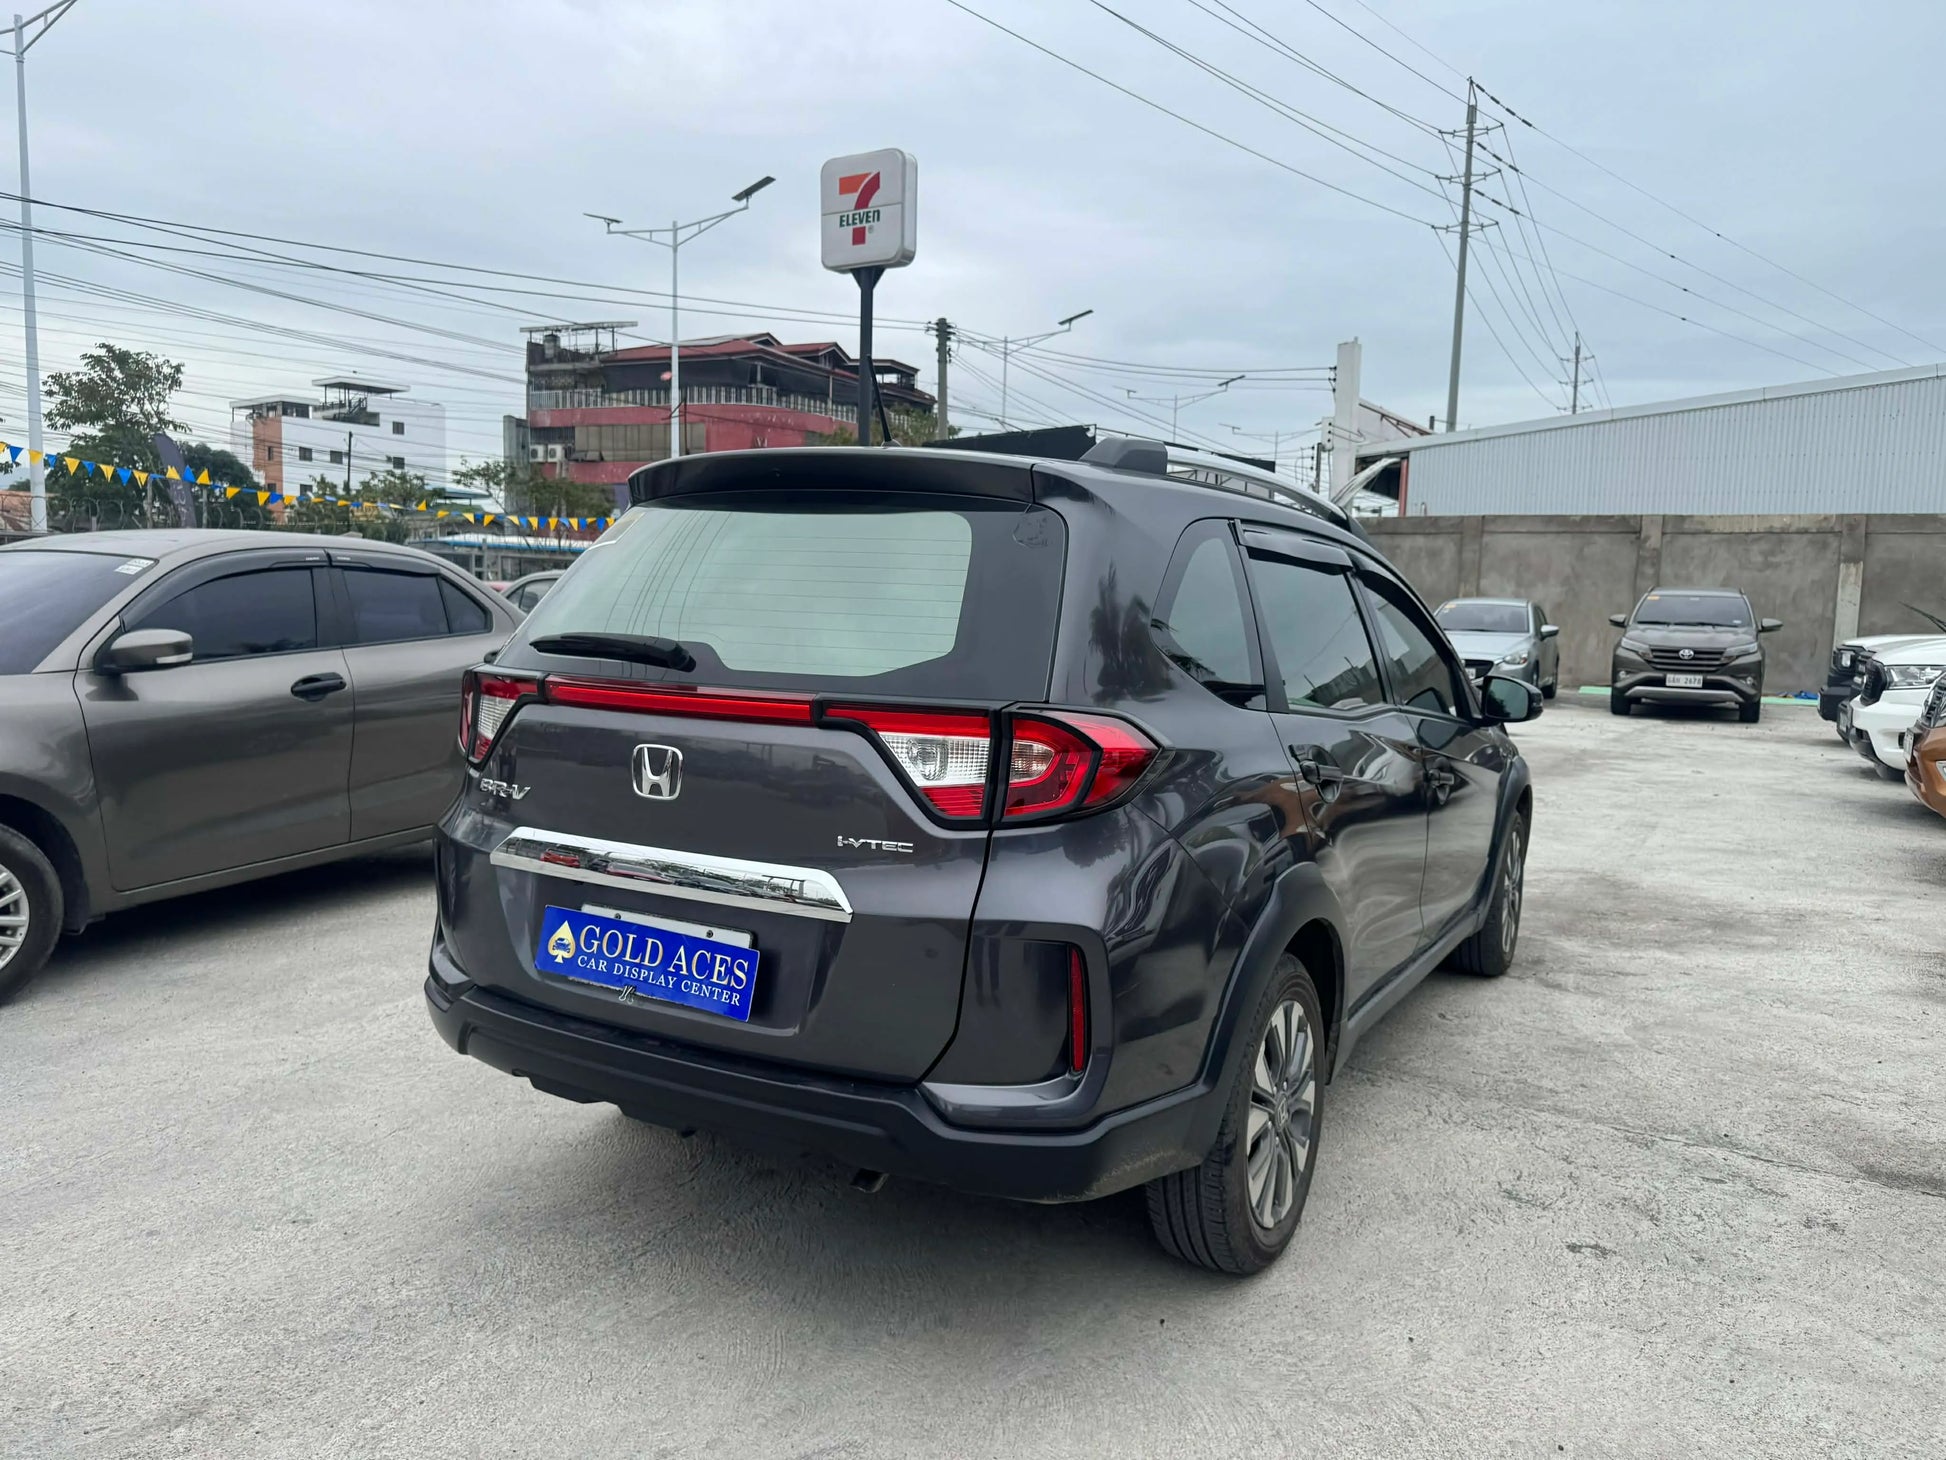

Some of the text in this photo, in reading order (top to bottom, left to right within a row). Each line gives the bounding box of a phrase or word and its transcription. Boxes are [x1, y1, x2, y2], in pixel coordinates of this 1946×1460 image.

[839, 171, 880, 245] 7
[481, 778, 531, 800] BR-V
[577, 956, 741, 1006] CAR DISPLAY CENTER
[580, 925, 749, 989] GOLD ACES
